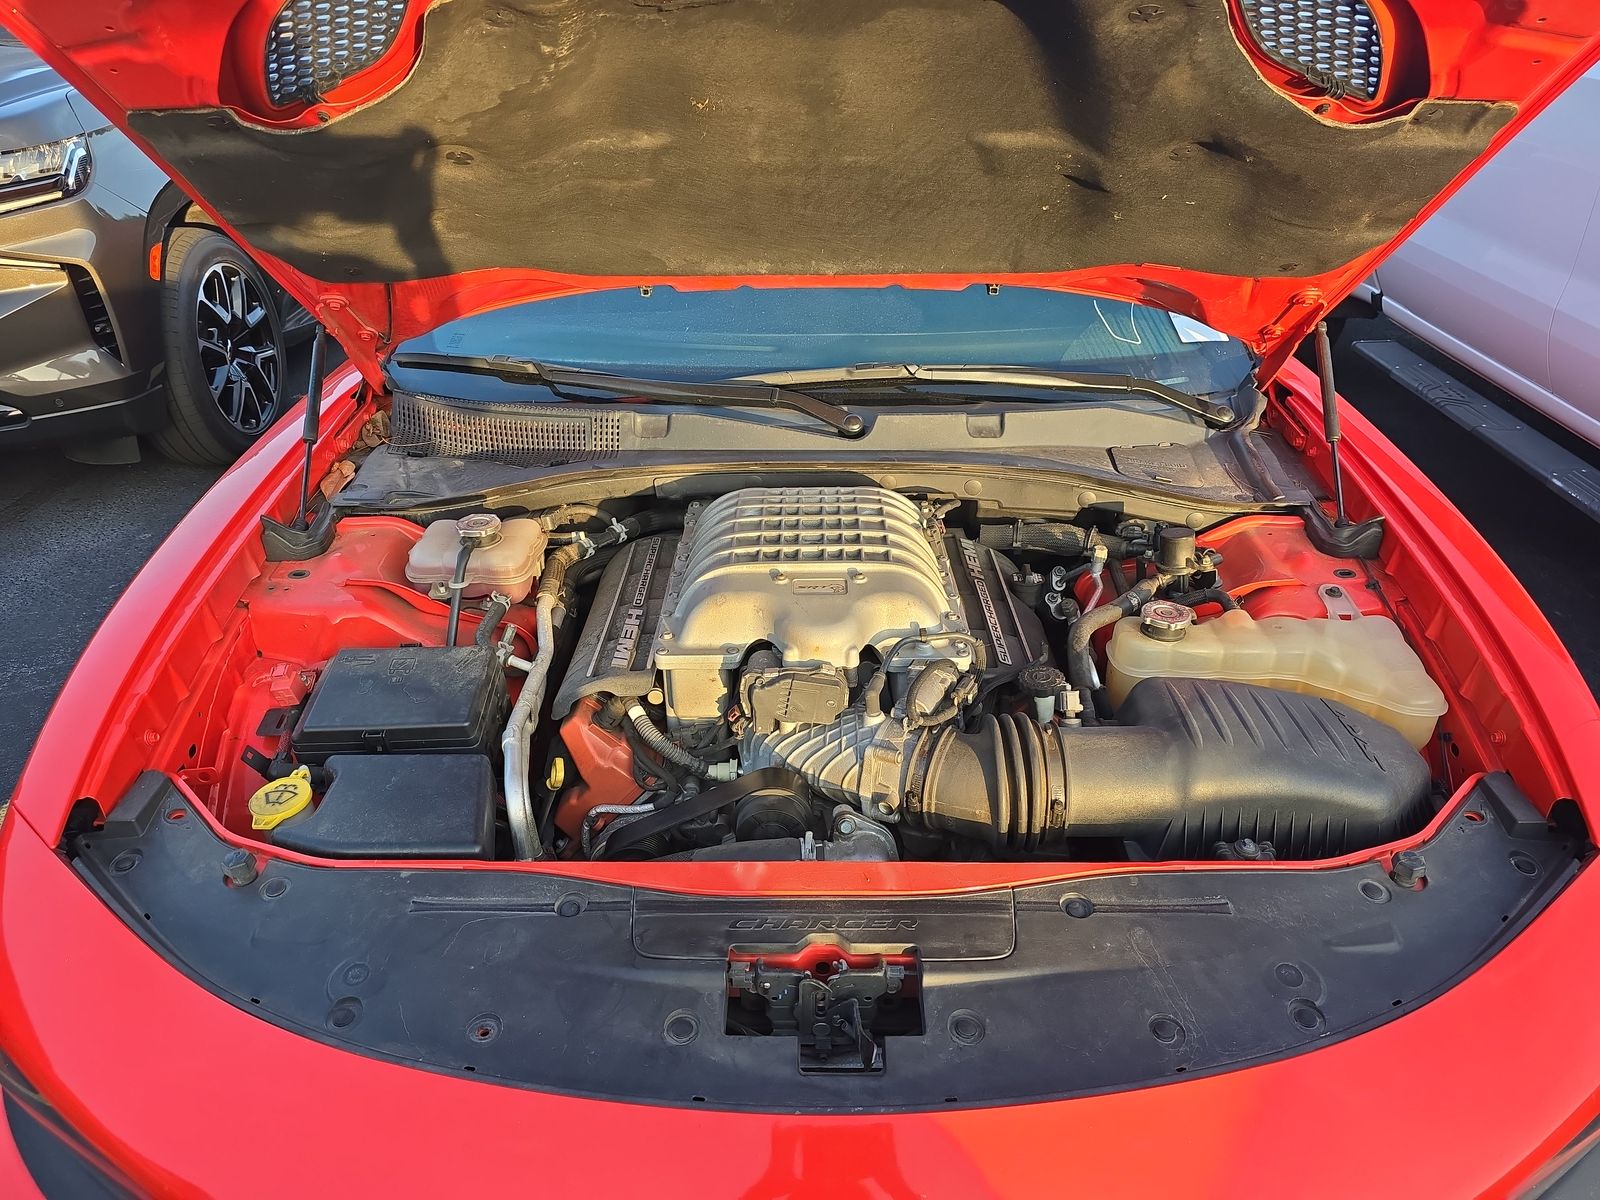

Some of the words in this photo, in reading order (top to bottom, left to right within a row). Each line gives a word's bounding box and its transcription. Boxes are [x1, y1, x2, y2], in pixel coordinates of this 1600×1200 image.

[633, 537, 661, 606] SUPERCHARGED
[960, 537, 985, 580] HEMI
[610, 608, 643, 669] HEMI
[975, 579, 1012, 665] SUPERCHARGED
[728, 917, 919, 931] CHARGER
